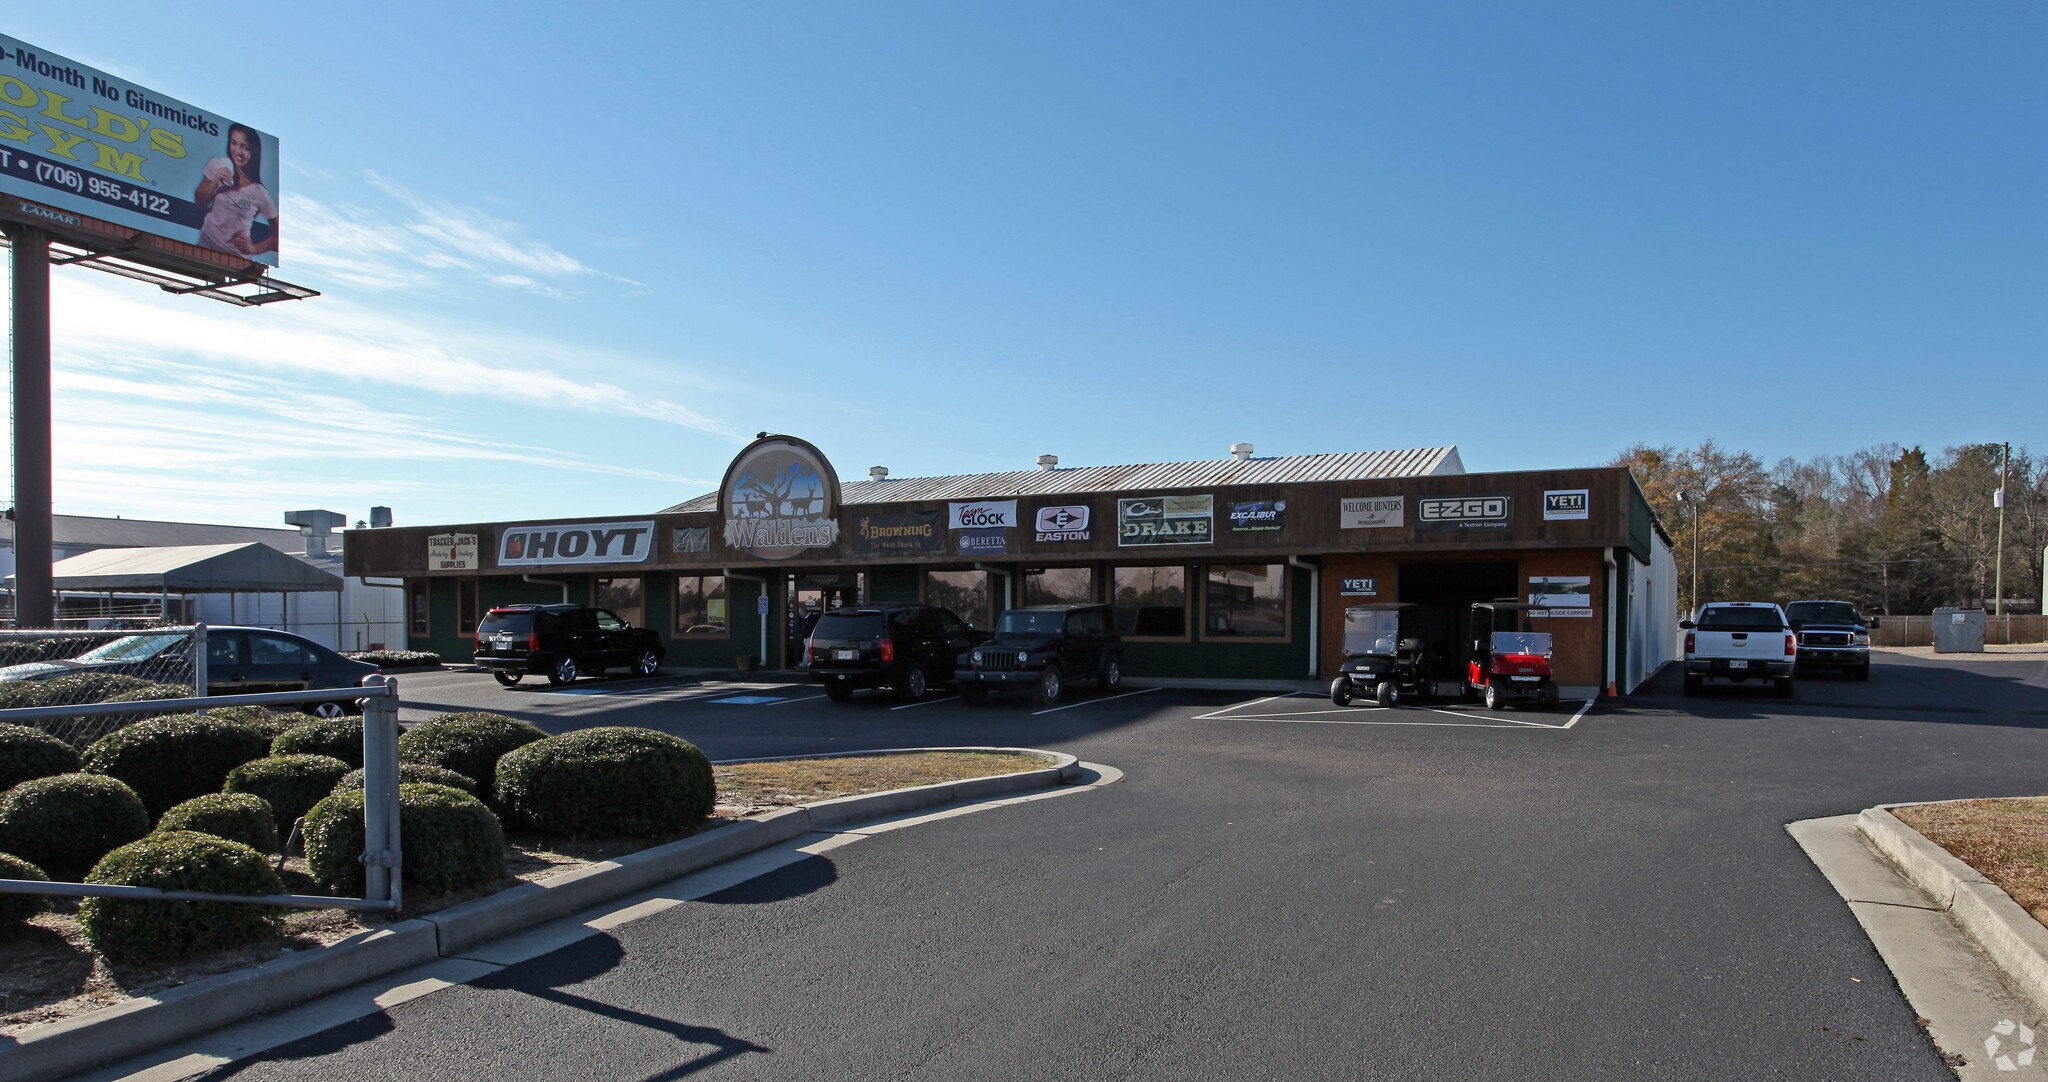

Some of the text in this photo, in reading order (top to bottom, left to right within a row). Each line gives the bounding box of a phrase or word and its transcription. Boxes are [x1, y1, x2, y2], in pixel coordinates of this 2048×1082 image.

[0, 46, 219, 136] -Month No Gimmicks
[36, 161, 84, 192] (706)
[88, 177, 170, 215] 955-4122
[20, 204, 75, 226] LAMAR
[1343, 500, 1402, 512] WELCOME HUNTERS
[1549, 495, 1582, 506] YETI
[959, 504, 993, 521] Team
[1230, 511, 1276, 519] EXCALIBUR
[962, 513, 1004, 526] GLOCK
[727, 518, 831, 549] Waldens
[870, 524, 932, 539] BROWNING
[1124, 521, 1208, 537] DRAKE
[429, 536, 477, 547] TRACKER JACK'S
[526, 528, 648, 559] HOYT
[971, 537, 1006, 546] BERETTA
[1036, 532, 1090, 542] EASTON
[440, 560, 466, 569] SUPPLIES
[1344, 579, 1373, 589] YETI
